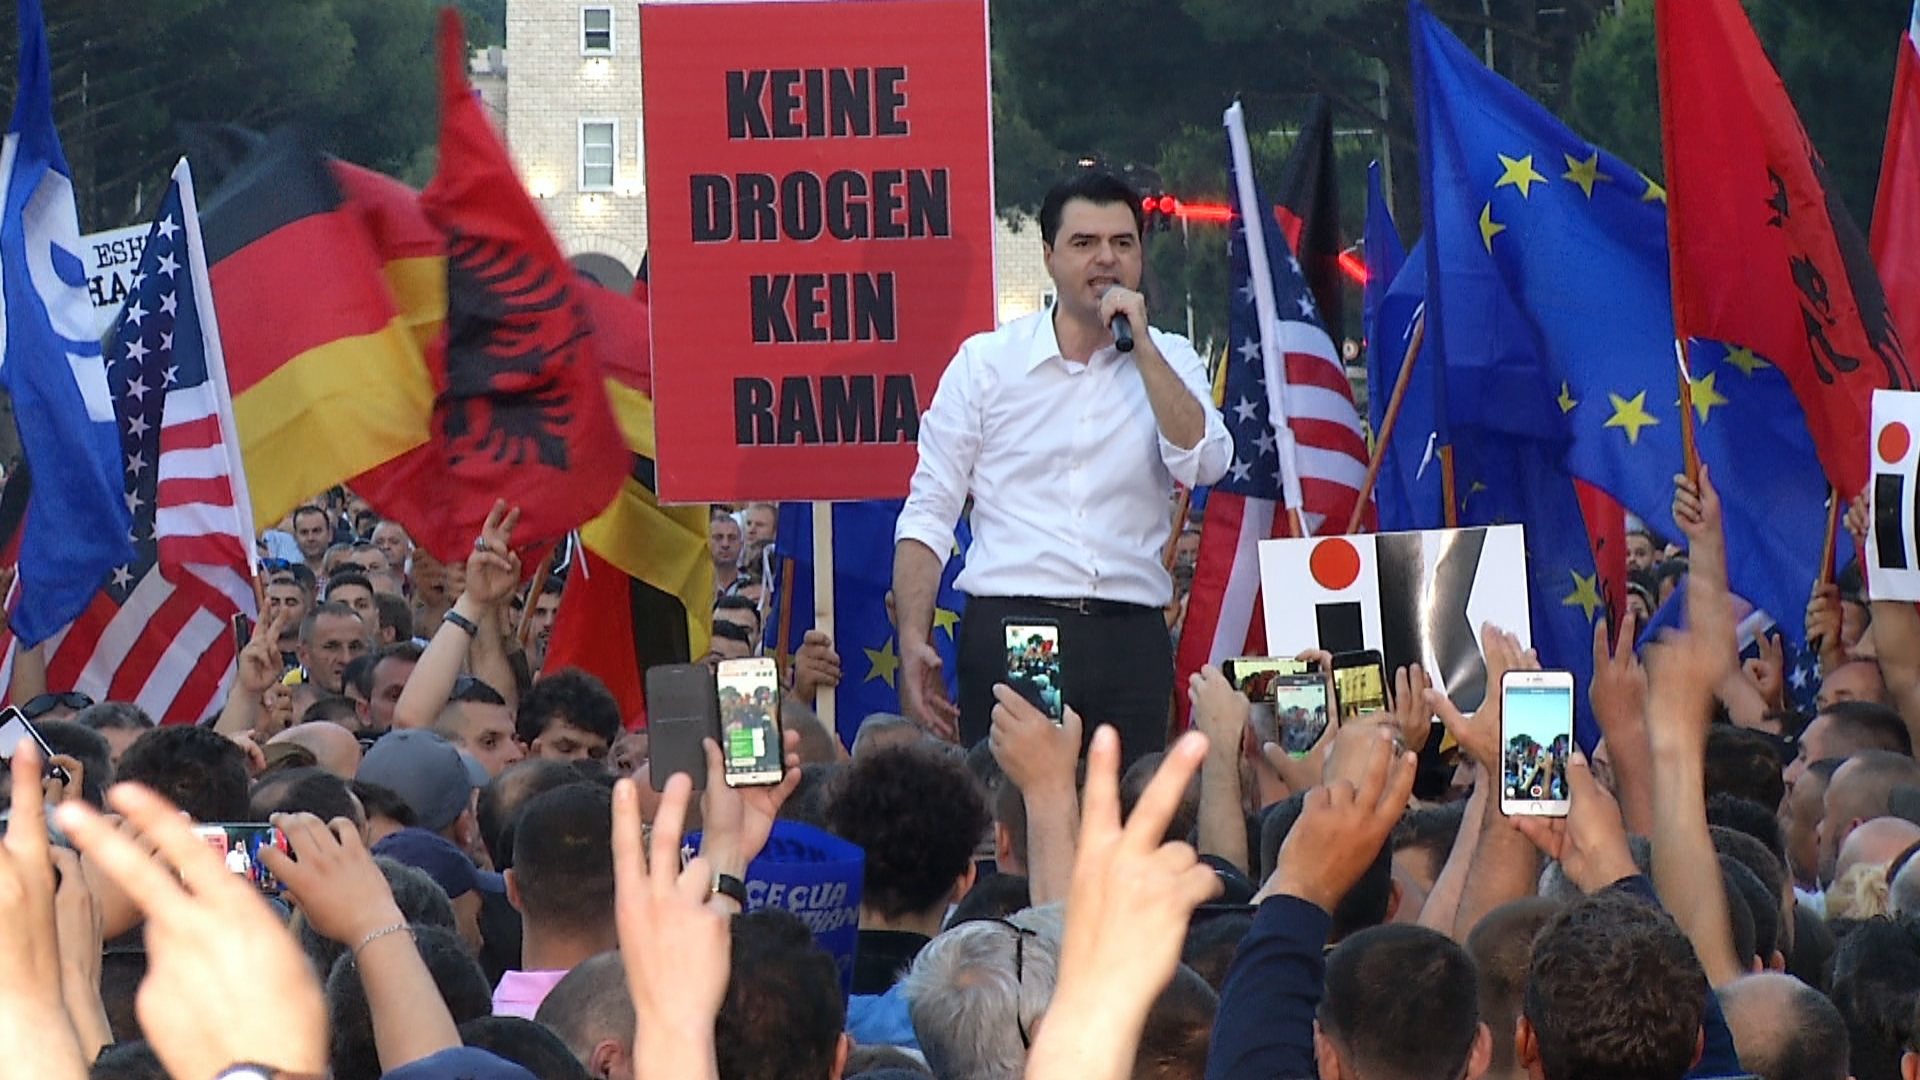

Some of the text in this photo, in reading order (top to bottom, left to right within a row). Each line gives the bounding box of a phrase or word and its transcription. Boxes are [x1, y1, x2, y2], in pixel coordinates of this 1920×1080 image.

[725, 66, 911, 141] KEINE
[689, 168, 952, 244] DROGEN
[92, 236, 149, 269] ESH
[749, 271, 898, 345] KEIN
[733, 374, 922, 447] RAMA
